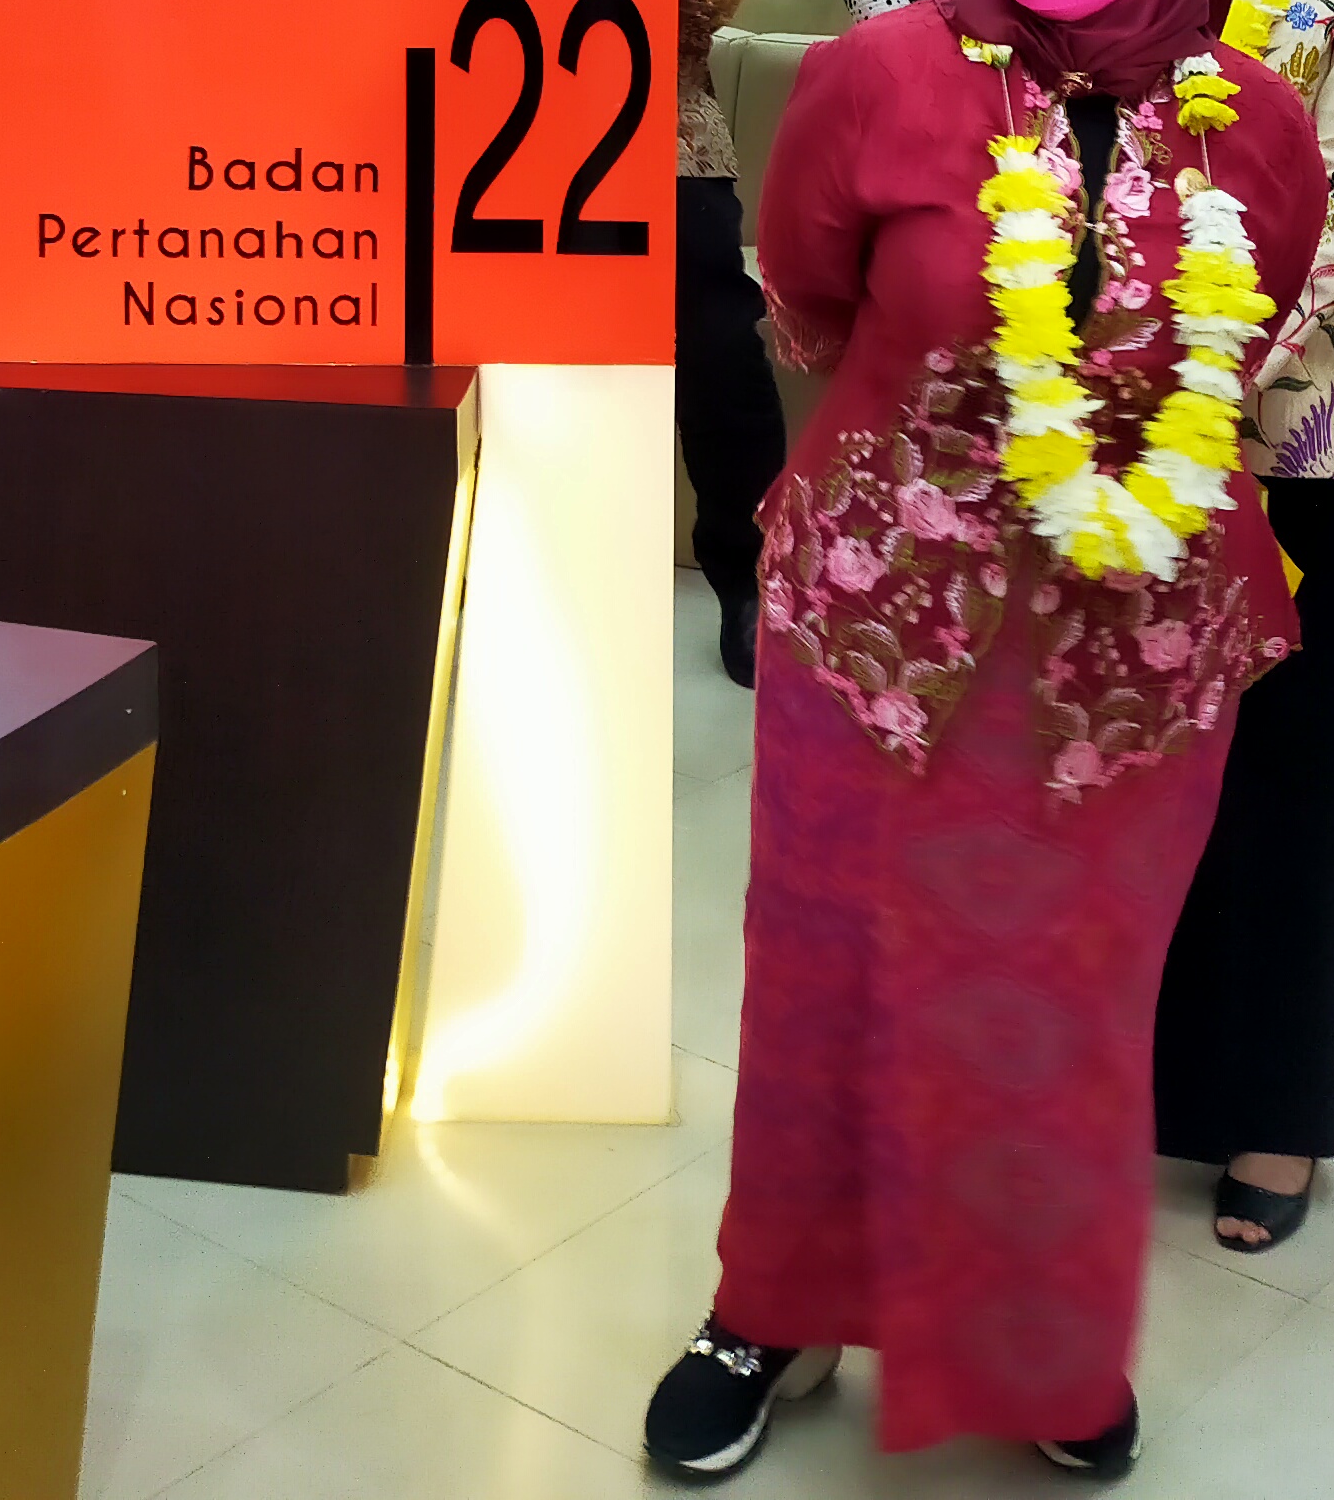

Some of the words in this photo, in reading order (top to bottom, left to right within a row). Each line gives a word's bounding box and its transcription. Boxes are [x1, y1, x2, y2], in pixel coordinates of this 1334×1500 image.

[187, 145, 380, 193] Badan
[37, 213, 379, 260] Pertanahan
[123, 281, 379, 328] Nasional
